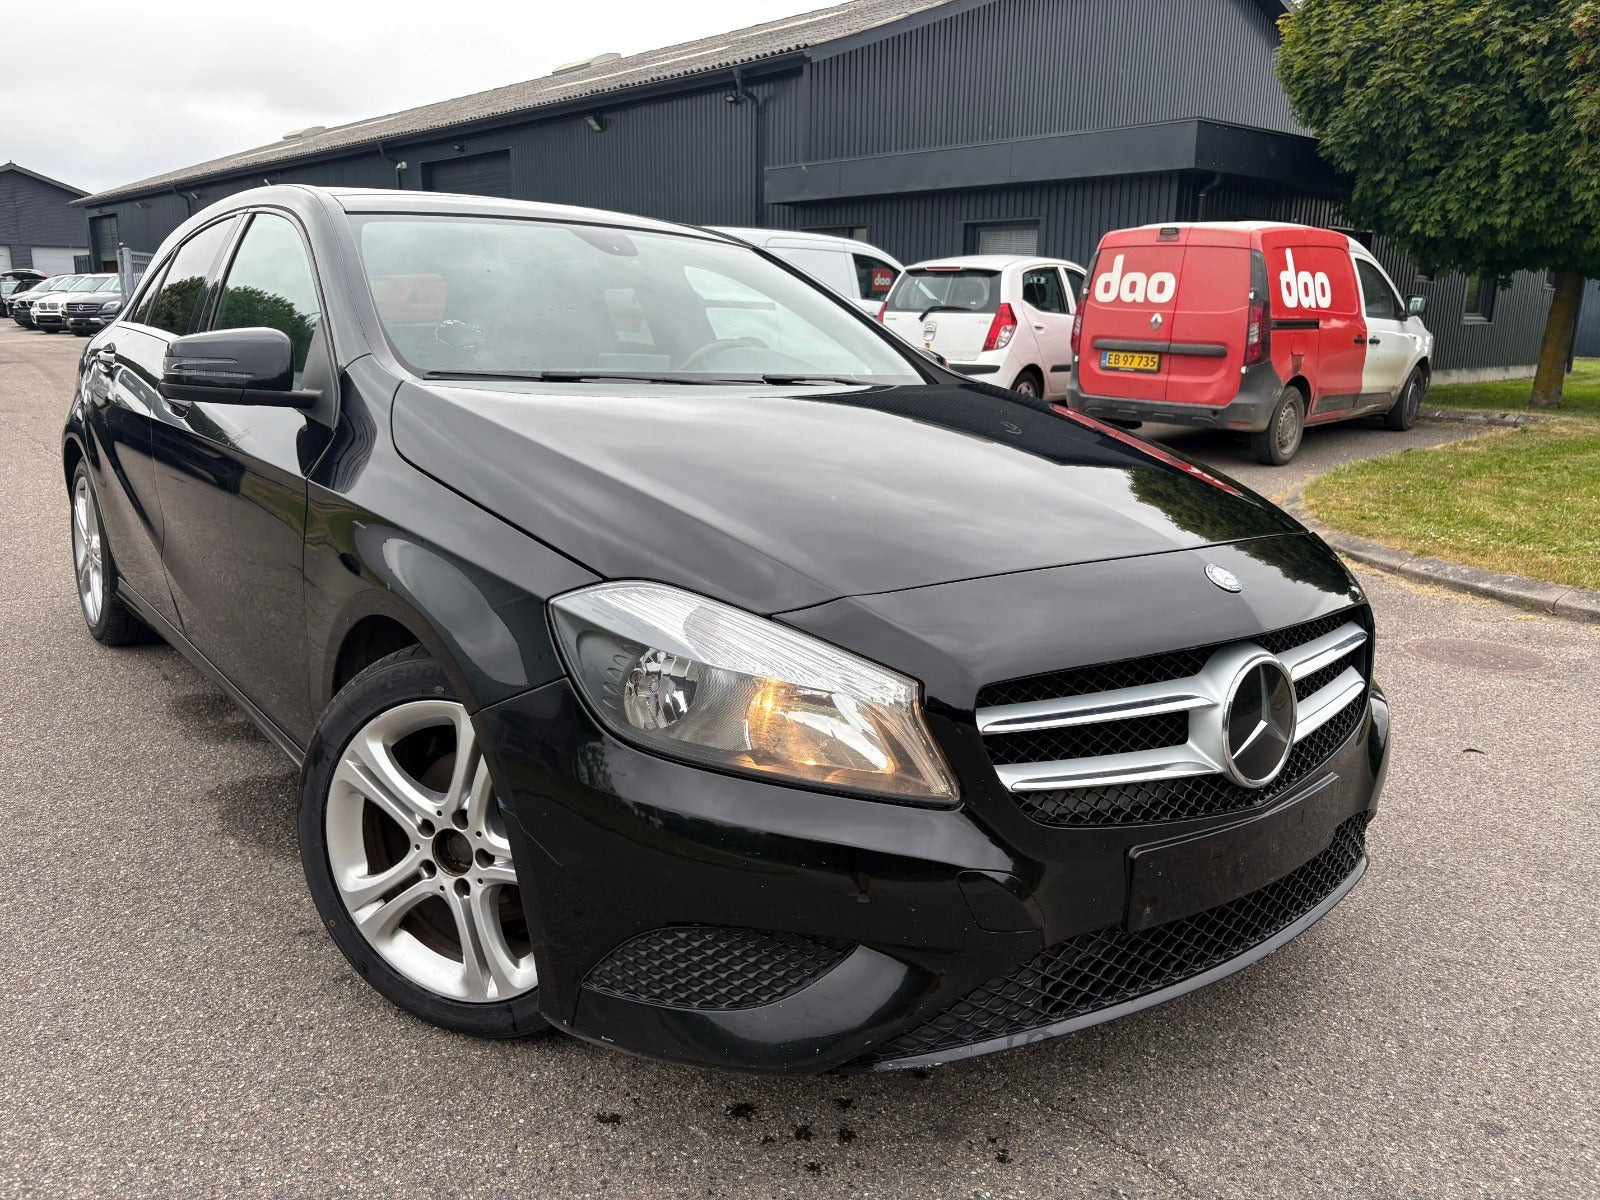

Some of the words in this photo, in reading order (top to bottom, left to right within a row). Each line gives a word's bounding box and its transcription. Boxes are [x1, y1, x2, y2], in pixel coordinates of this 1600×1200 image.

[874, 273, 891, 286] dao
[1094, 253, 1176, 304] dao
[1279, 247, 1332, 309] dao
[1107, 353, 1120, 365] EB
[1122, 354, 1135, 366] 97
[1137, 356, 1157, 368] 735
